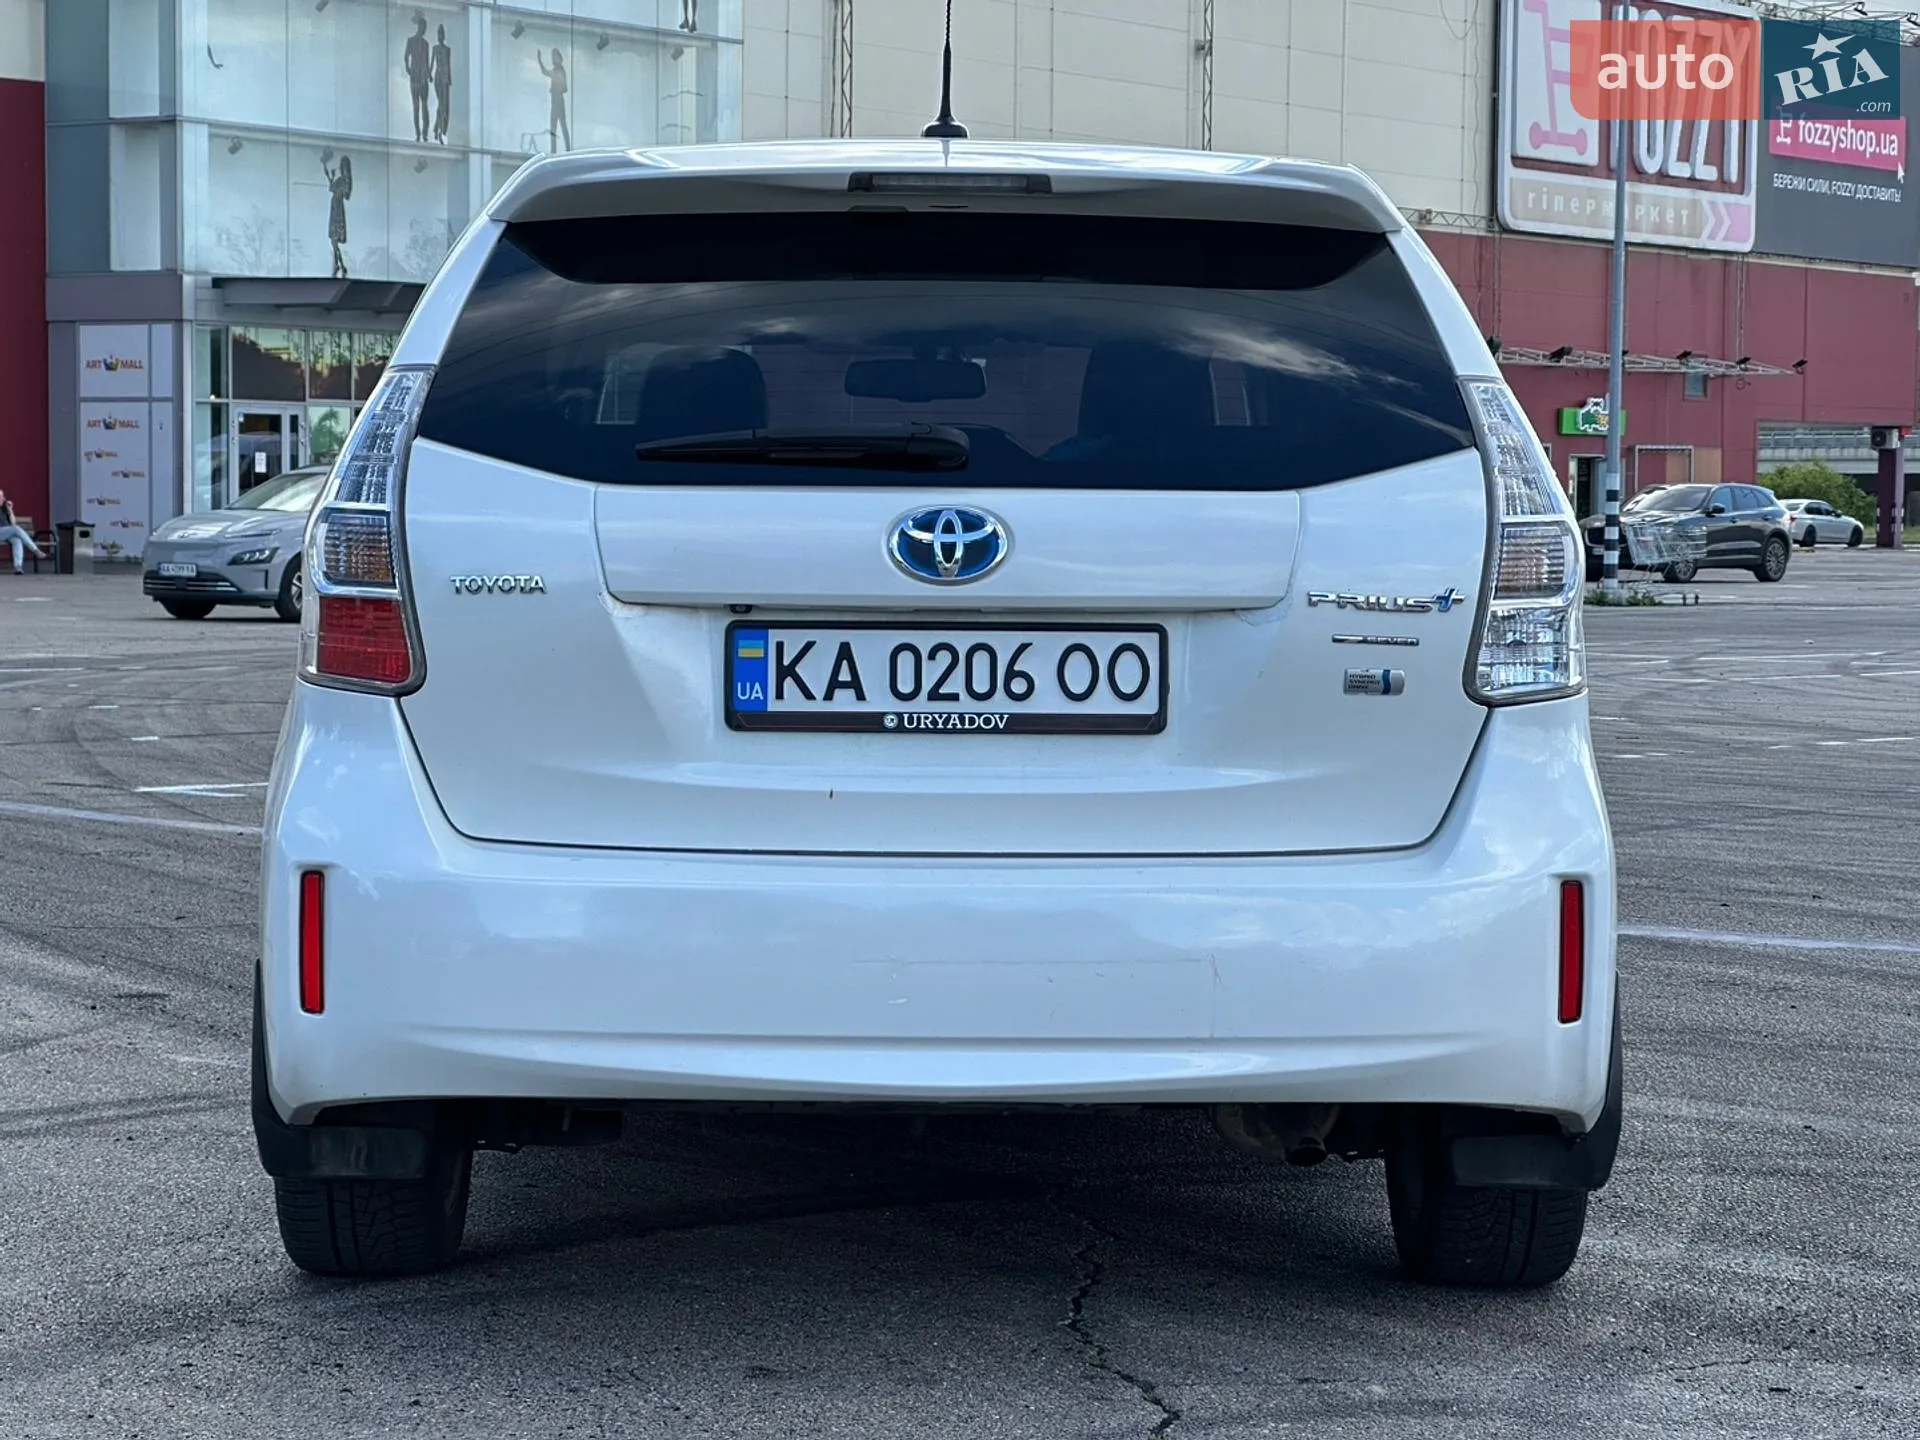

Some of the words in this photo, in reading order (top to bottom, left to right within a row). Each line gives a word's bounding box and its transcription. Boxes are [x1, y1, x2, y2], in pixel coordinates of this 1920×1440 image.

[1798, 113, 1898, 158] fozzyshop.ua
[86, 359, 102, 369] ART
[121, 359, 144, 369] MALL
[86, 419, 101, 428] ART
[450, 575, 547, 594] TOYOTA
[775, 640, 867, 701] KA
[889, 642, 1035, 702] 0206
[1057, 642, 1151, 702] OO
[737, 682, 764, 700] UA
[903, 713, 1010, 730] URYADOV
